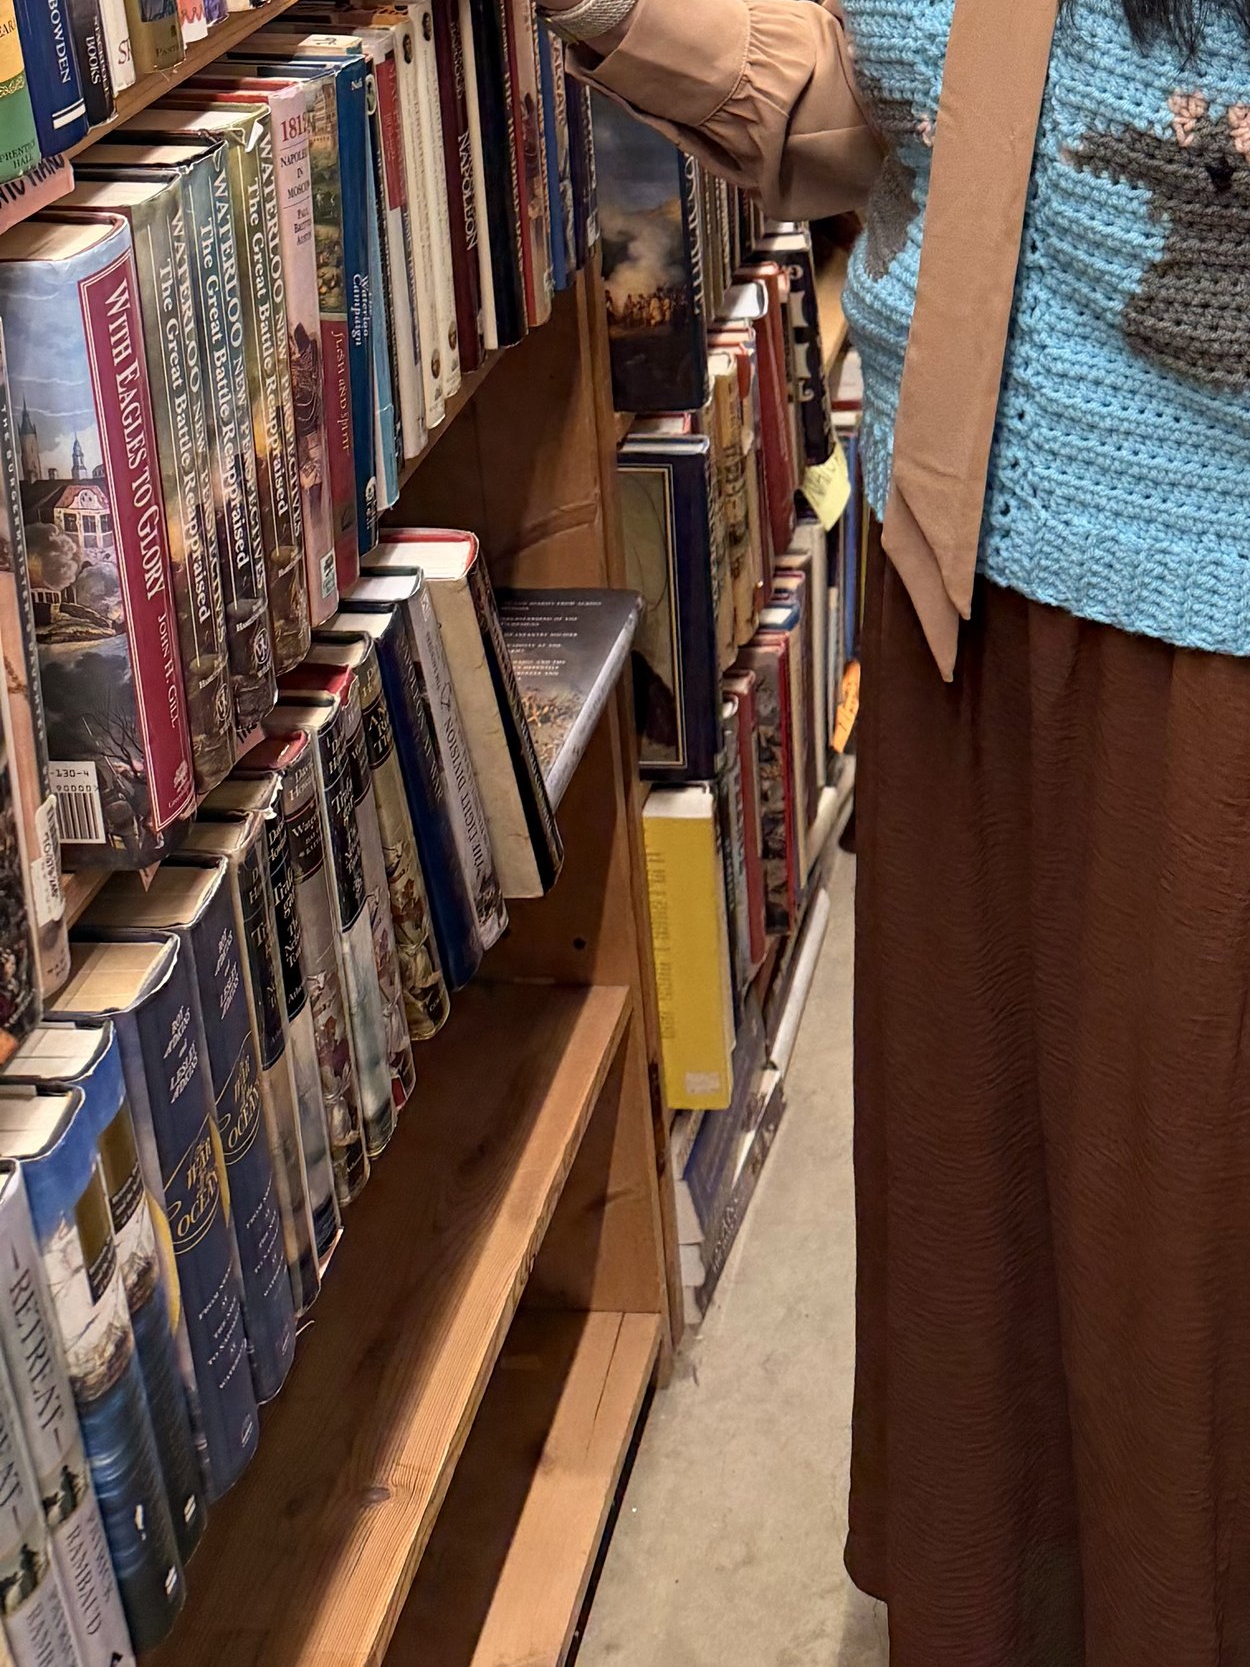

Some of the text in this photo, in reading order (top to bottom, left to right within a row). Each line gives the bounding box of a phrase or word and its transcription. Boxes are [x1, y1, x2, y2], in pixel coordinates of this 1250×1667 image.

[85, 35, 101, 86] BOOKS
[211, 167, 243, 348] WATERLOO
[259, 133, 284, 304] WATERLOO
[458, 130, 478, 251] NAPOLEON
[171, 208, 200, 394] WATERLOO
[247, 177, 289, 517] The Great Battle Reappraised
[159, 257, 211, 625] The Great Battle Reappraised
[200, 216, 250, 571] The Great Battle Reappraised
[105, 278, 181, 729] WITH EAGLES TO GLORY JOHN GILL
[9, 1268, 65, 1430] RETREAT
[65, 1525, 103, 1636] RAMBAUD
